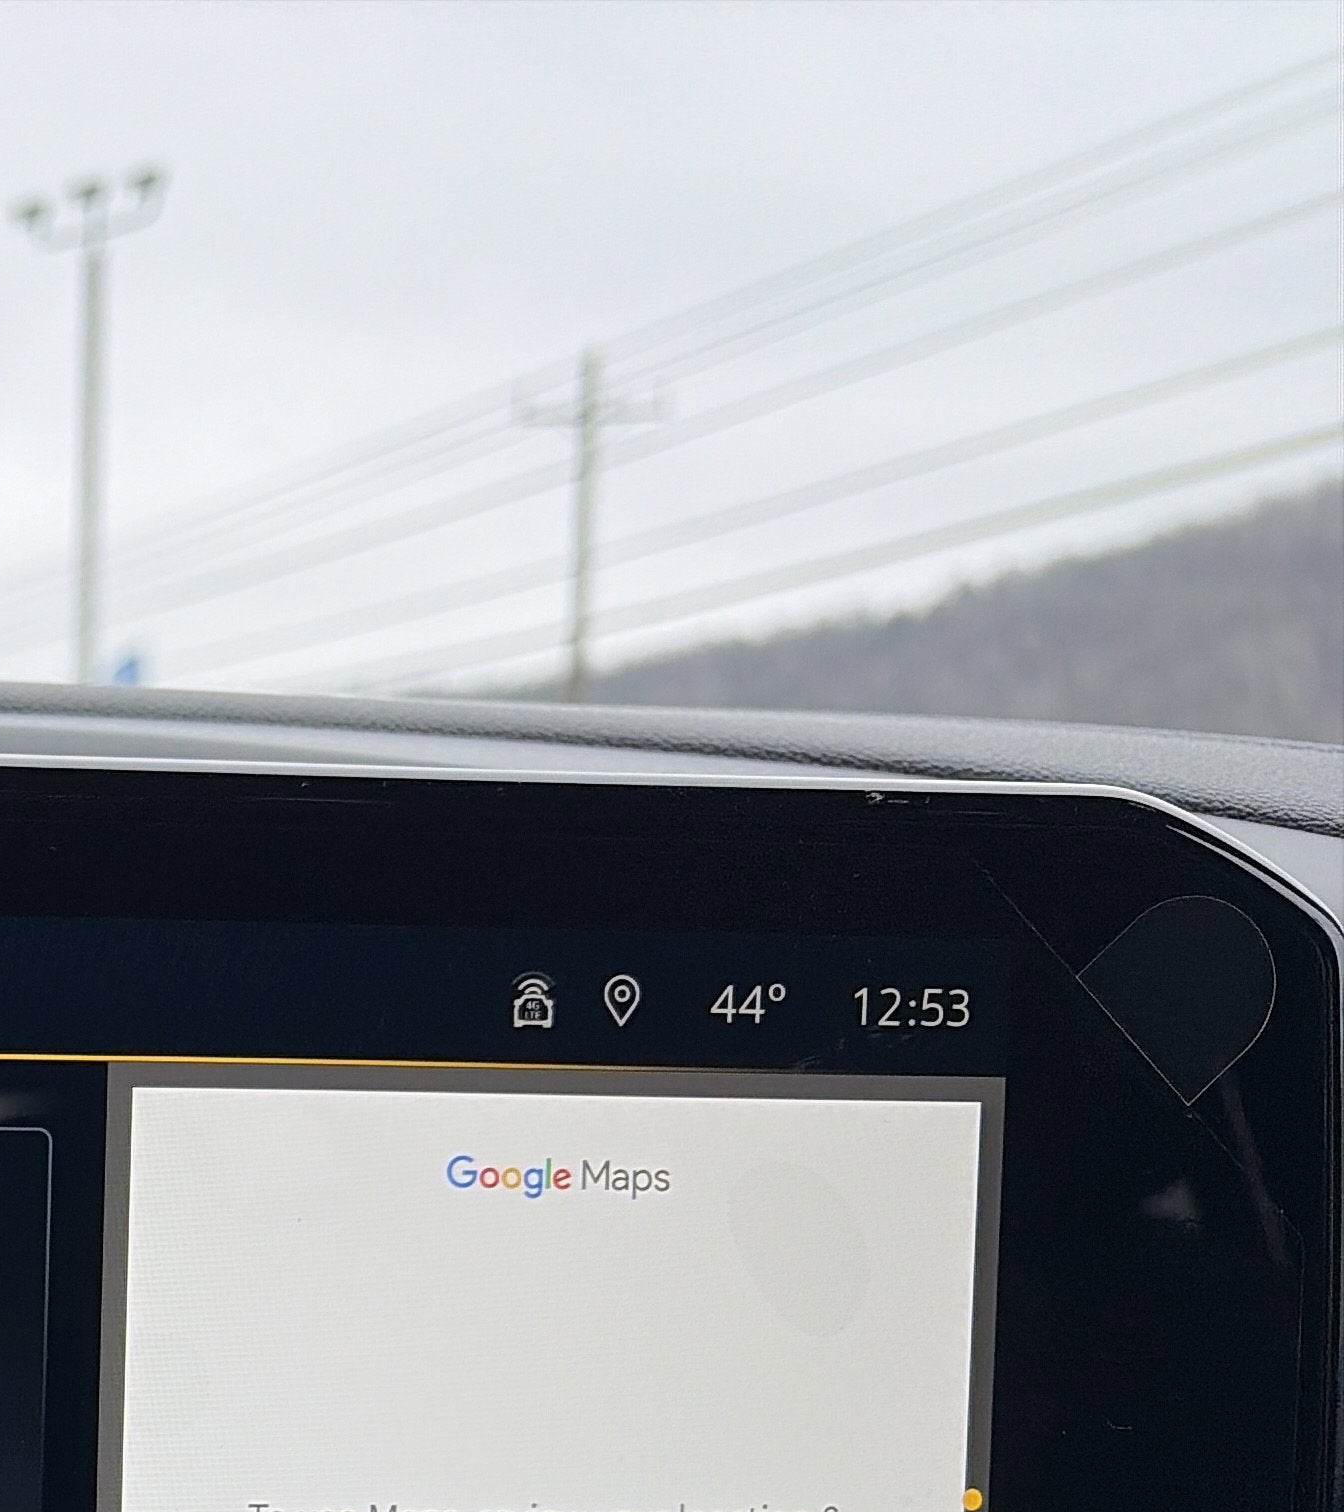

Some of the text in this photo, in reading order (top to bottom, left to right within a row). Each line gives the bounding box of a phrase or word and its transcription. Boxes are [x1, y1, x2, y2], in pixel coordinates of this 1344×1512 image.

[710, 983, 787, 1024] 44°
[852, 985, 971, 1029] 12:53
[446, 1155, 671, 1201] Google Maps
